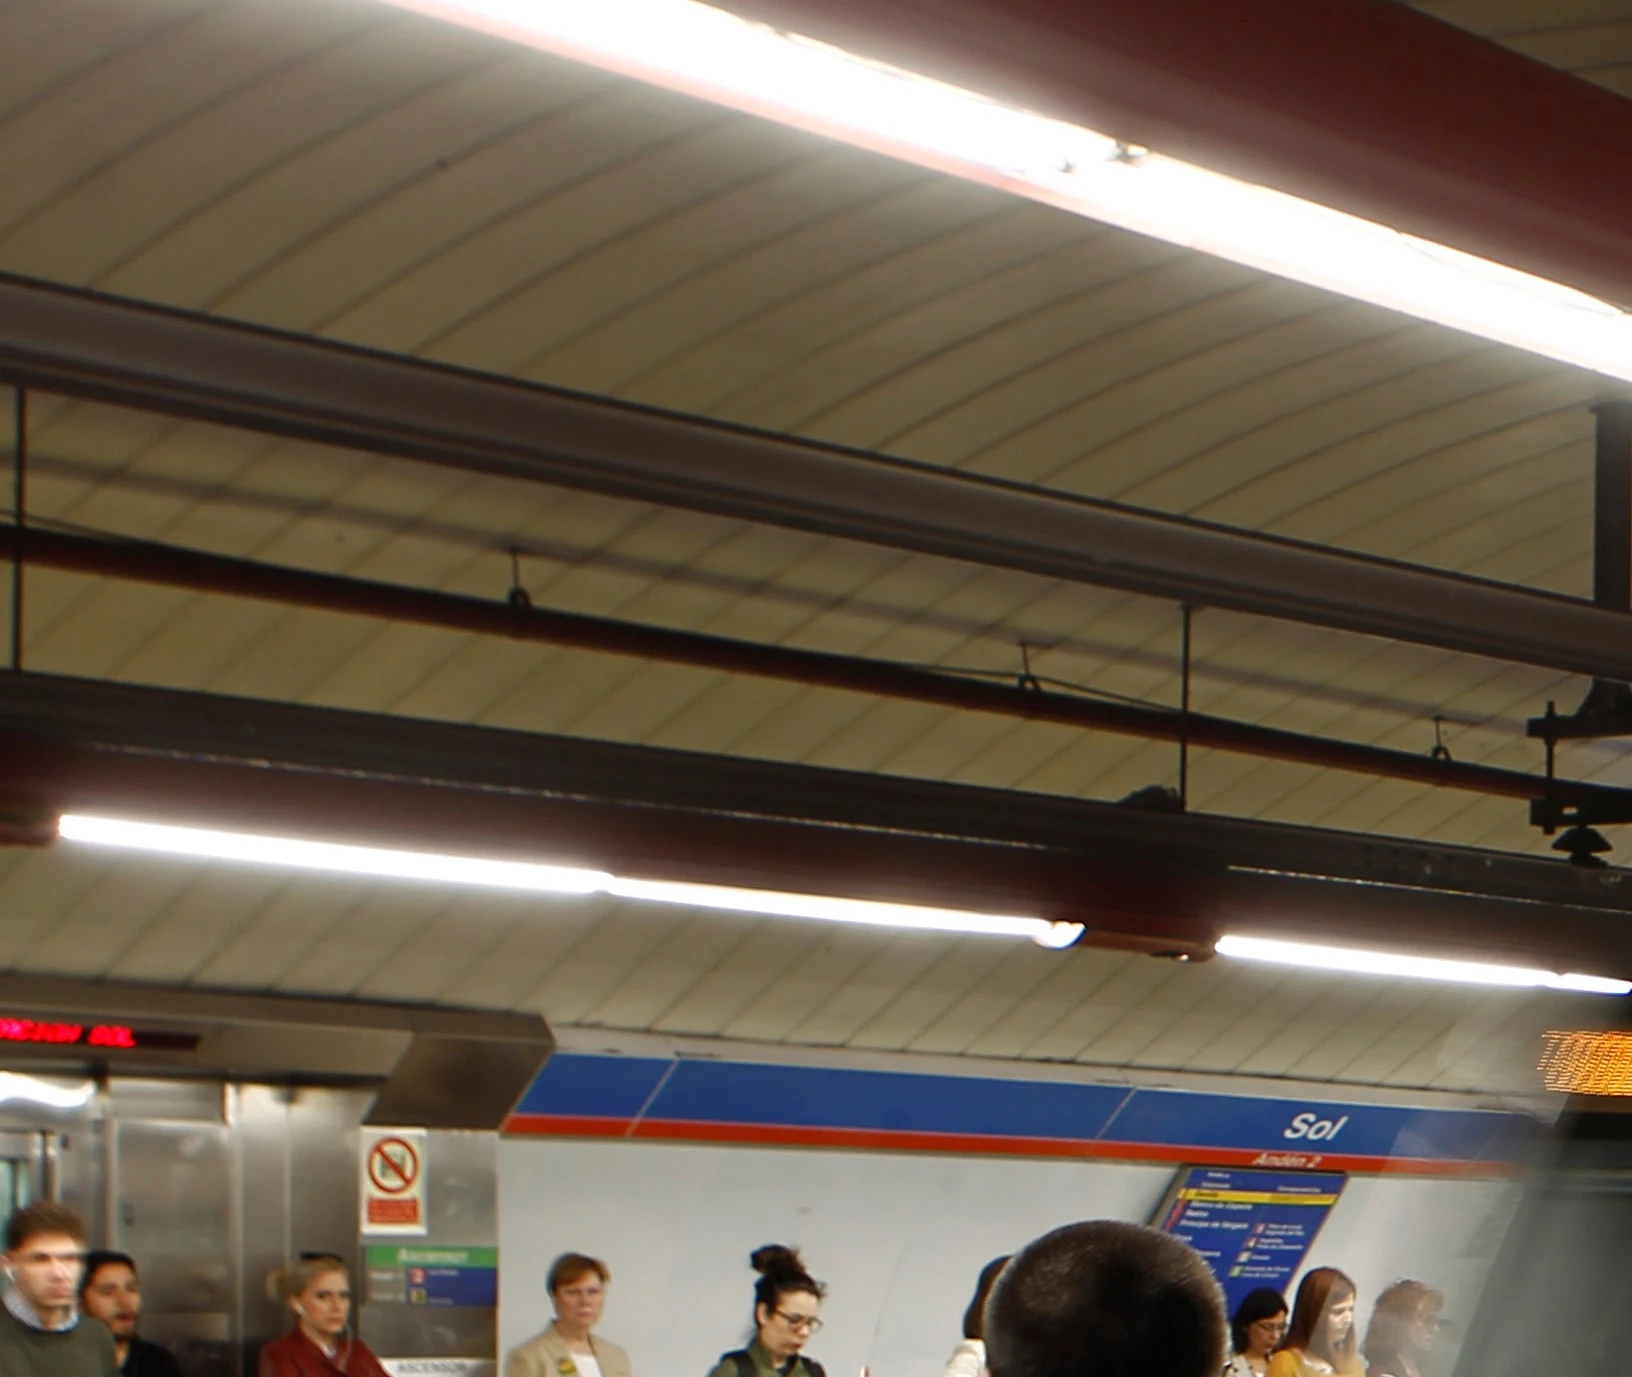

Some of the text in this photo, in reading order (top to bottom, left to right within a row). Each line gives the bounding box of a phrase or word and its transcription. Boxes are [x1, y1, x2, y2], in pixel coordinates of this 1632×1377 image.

[1283, 1112, 1350, 1141] Sol
[1252, 1151, 1322, 1169] Andén 2
